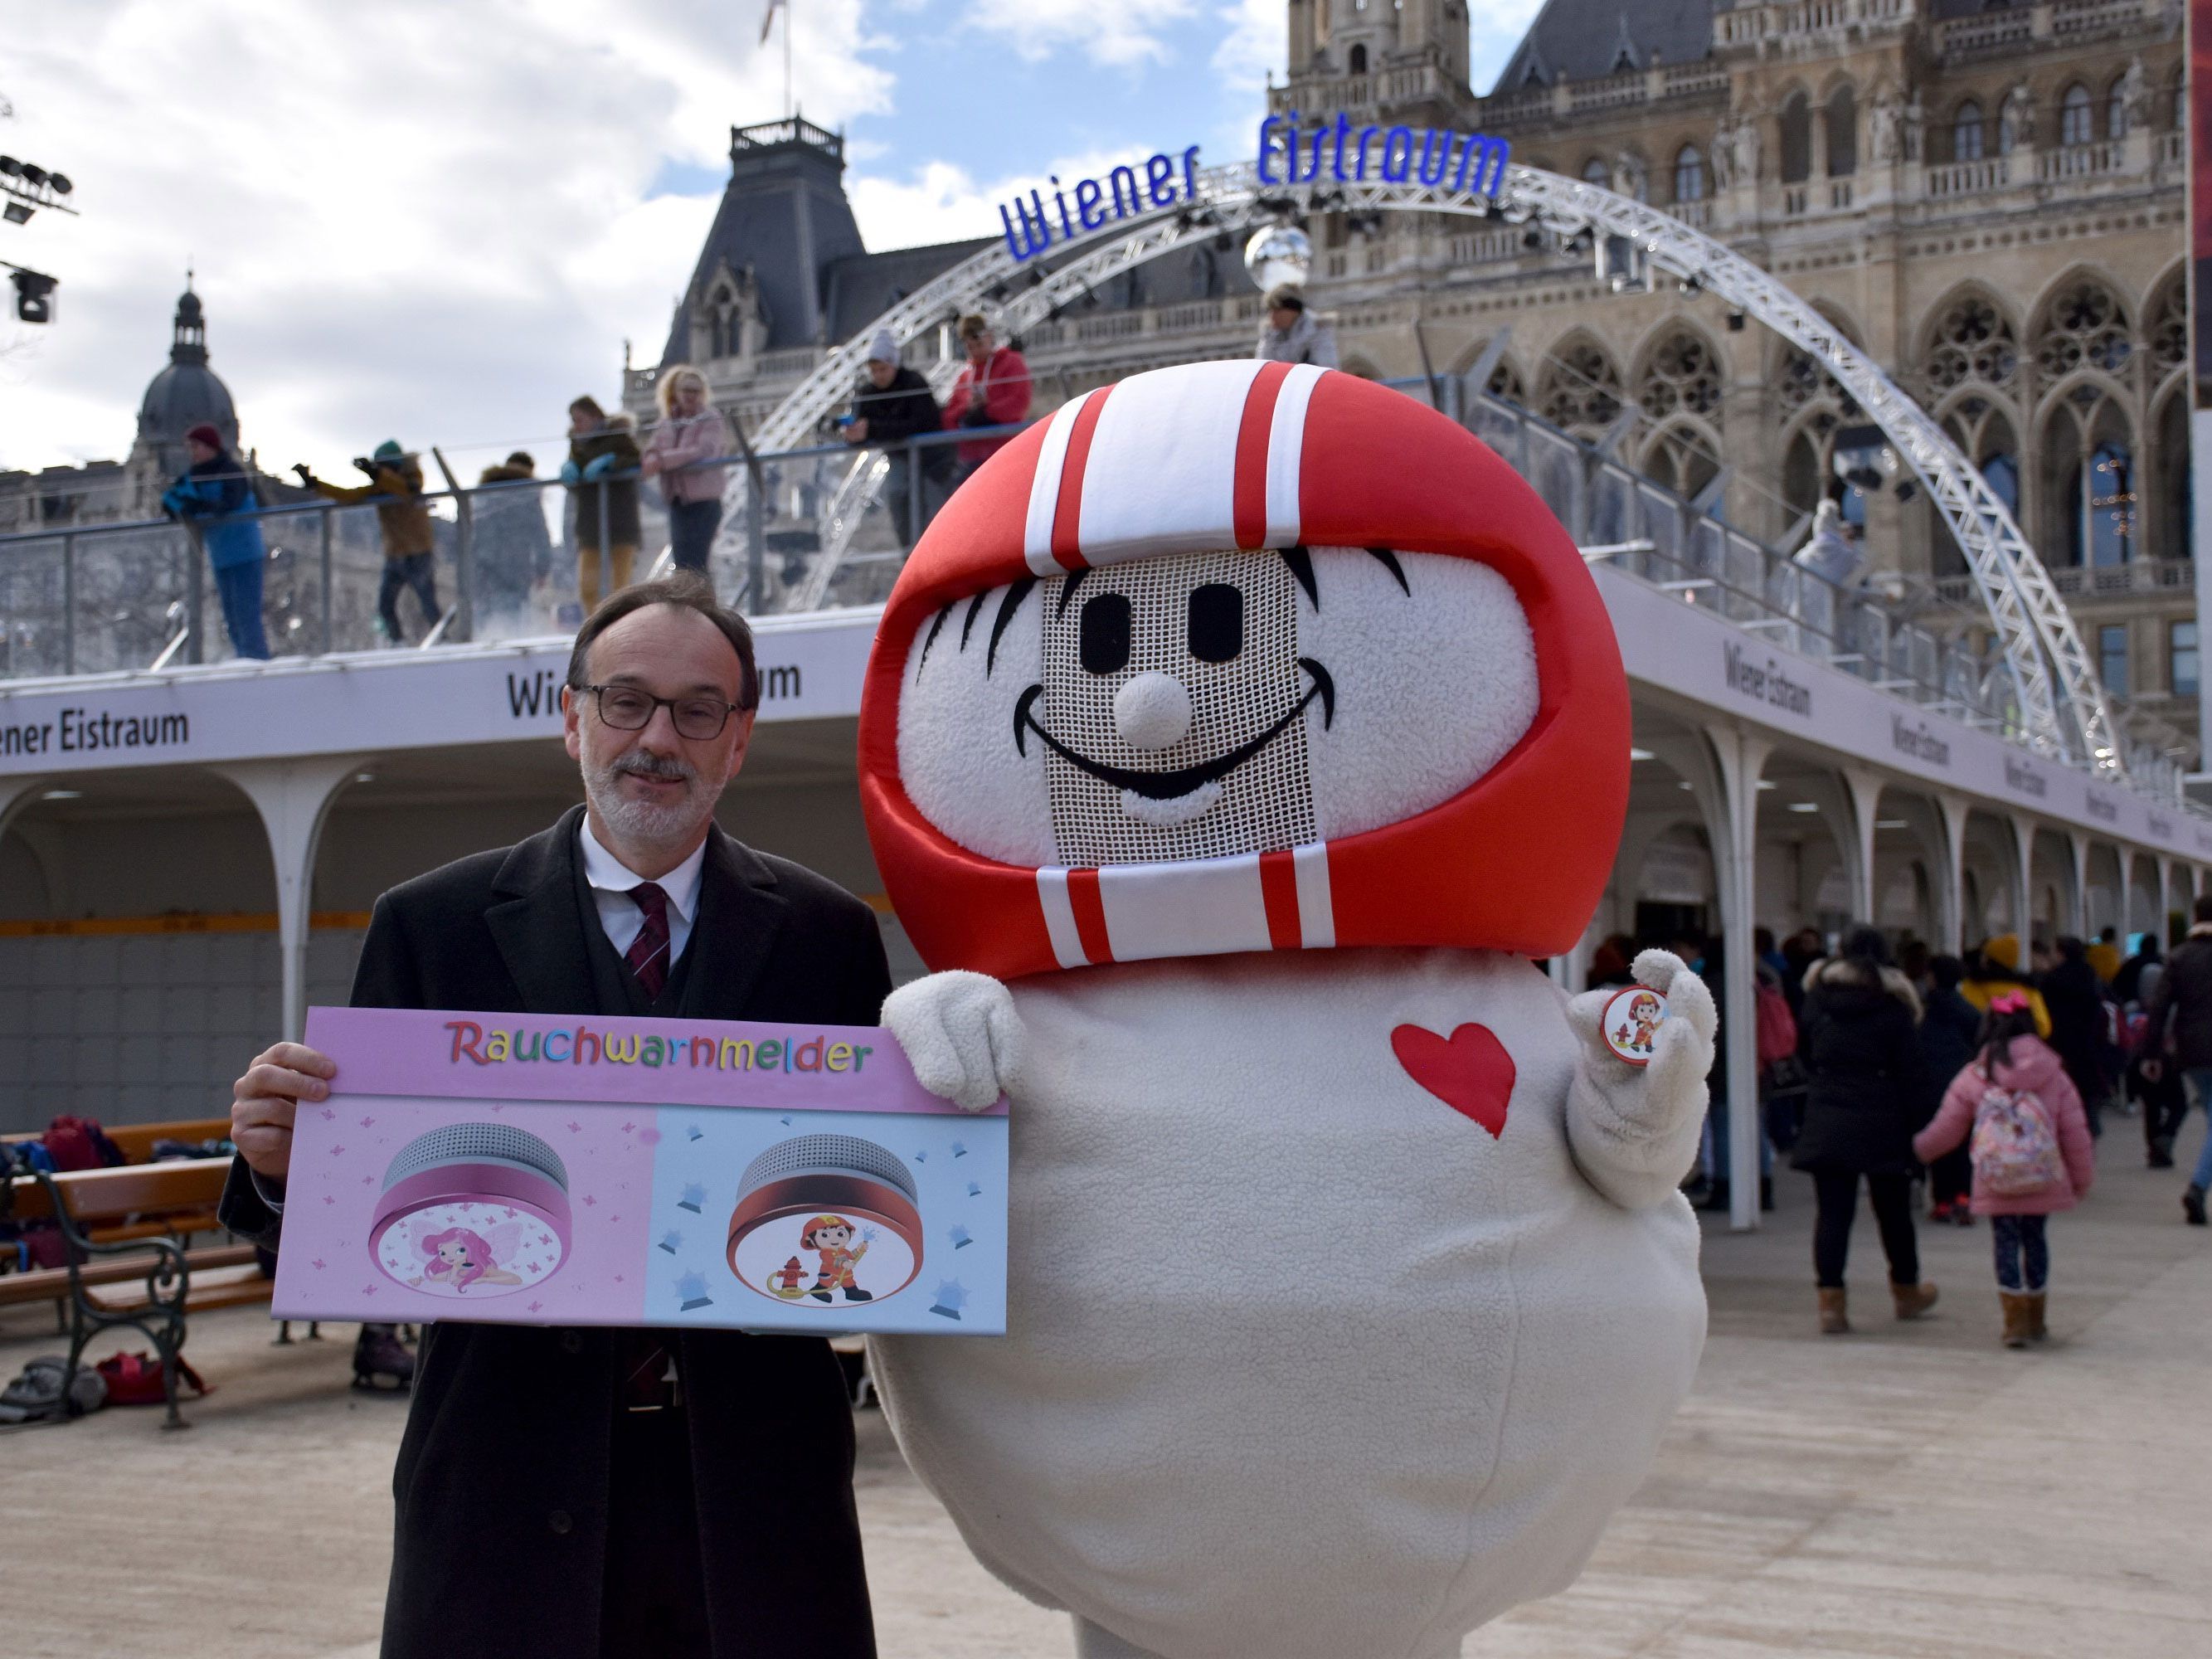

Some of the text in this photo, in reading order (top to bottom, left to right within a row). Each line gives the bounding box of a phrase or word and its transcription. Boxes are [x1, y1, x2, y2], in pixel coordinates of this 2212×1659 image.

[999, 111, 1511, 262] Wiener Eistraum
[60, 708, 190, 752] Eistraum
[444, 1020, 874, 1073] Rauchwarnmelder
